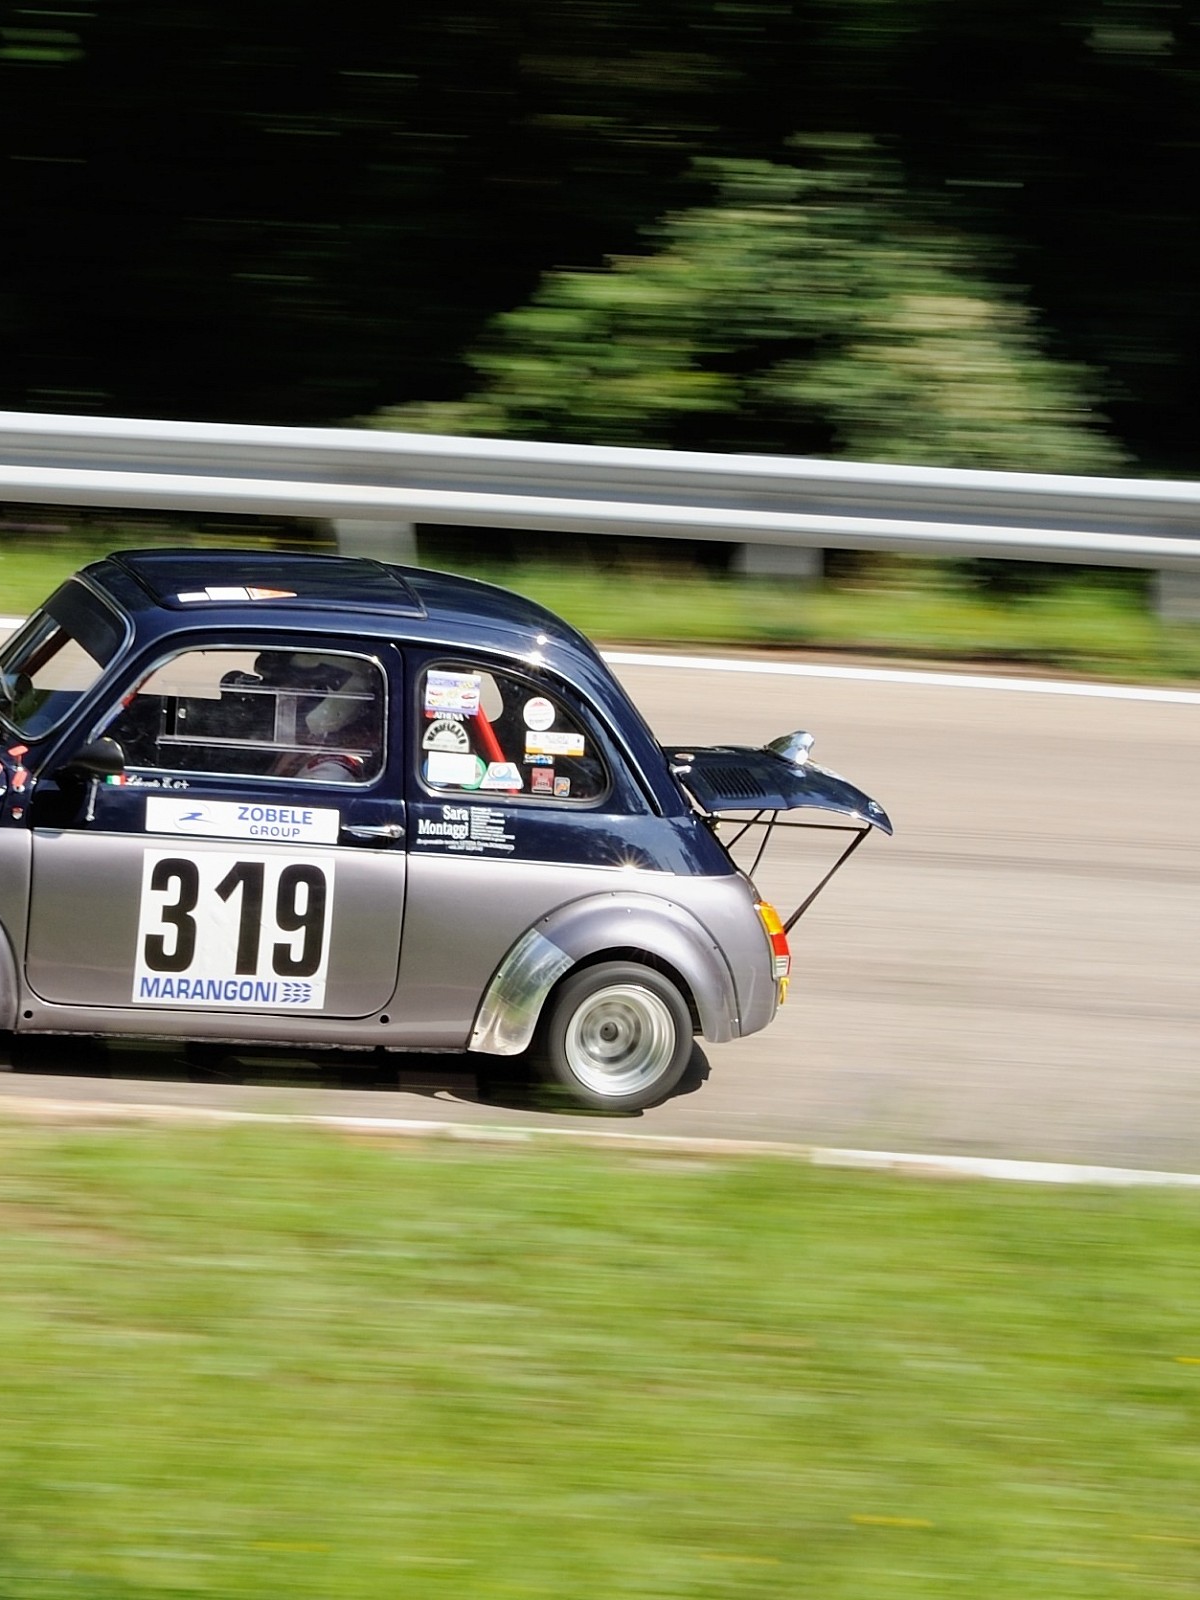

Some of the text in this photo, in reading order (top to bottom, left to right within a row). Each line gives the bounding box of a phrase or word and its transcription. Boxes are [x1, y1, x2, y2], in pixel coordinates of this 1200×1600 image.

[237, 806, 313, 825] ZOBELE
[443, 805, 469, 820] Sara
[249, 825, 301, 838] GROUP
[418, 819, 469, 839] Montaggi
[144, 857, 327, 977] 319
[140, 976, 278, 1003] MARANGONI
